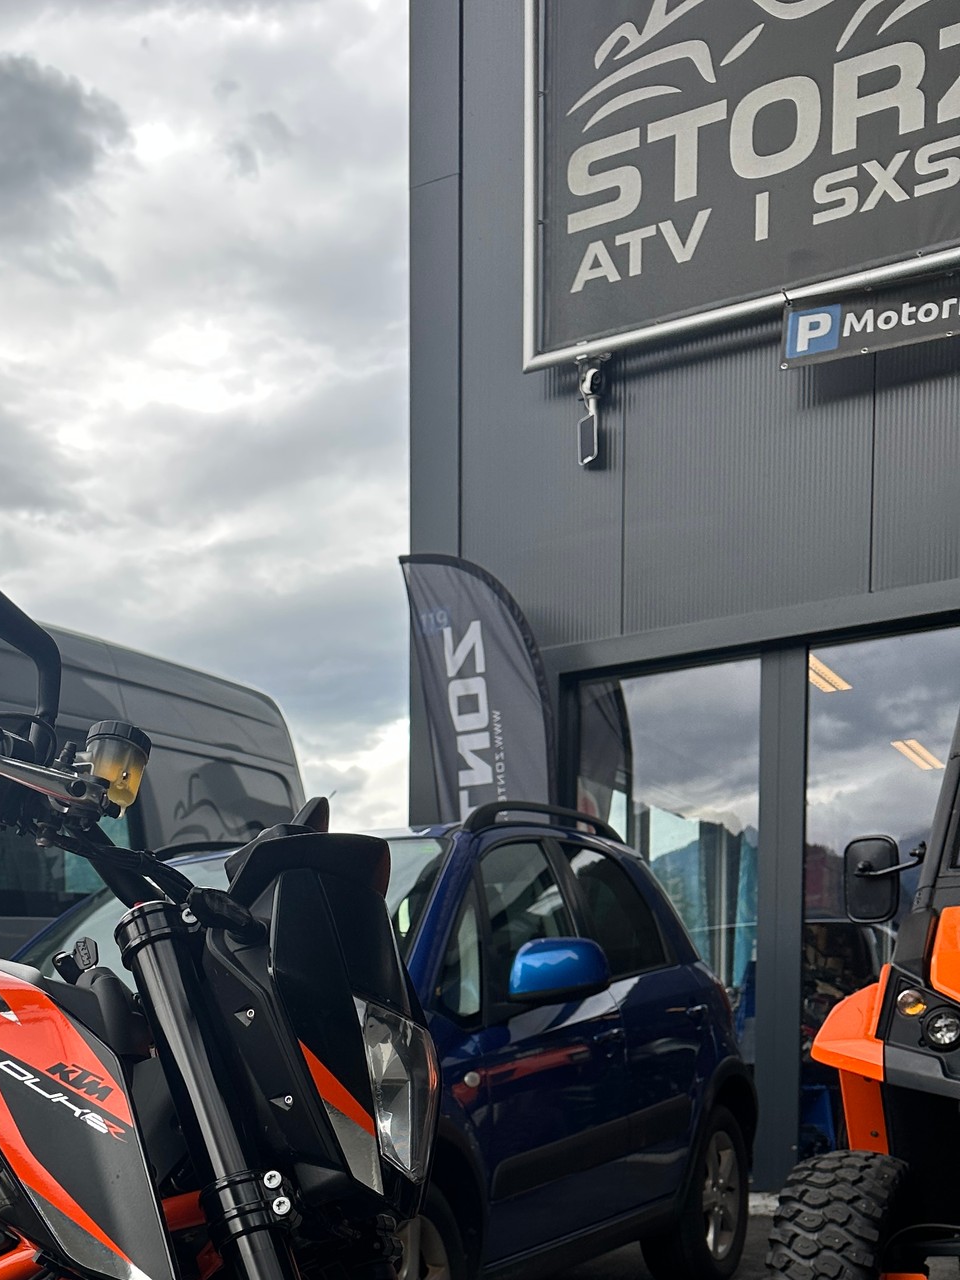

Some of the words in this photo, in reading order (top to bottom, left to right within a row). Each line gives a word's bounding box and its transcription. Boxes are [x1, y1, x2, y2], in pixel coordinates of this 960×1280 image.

[570, 208, 712, 293] ATV
[813, 135, 960, 225] SXS
[795, 312, 832, 353] P
[843, 297, 960, 337] Motor
[45, 1062, 114, 1103] KTM
